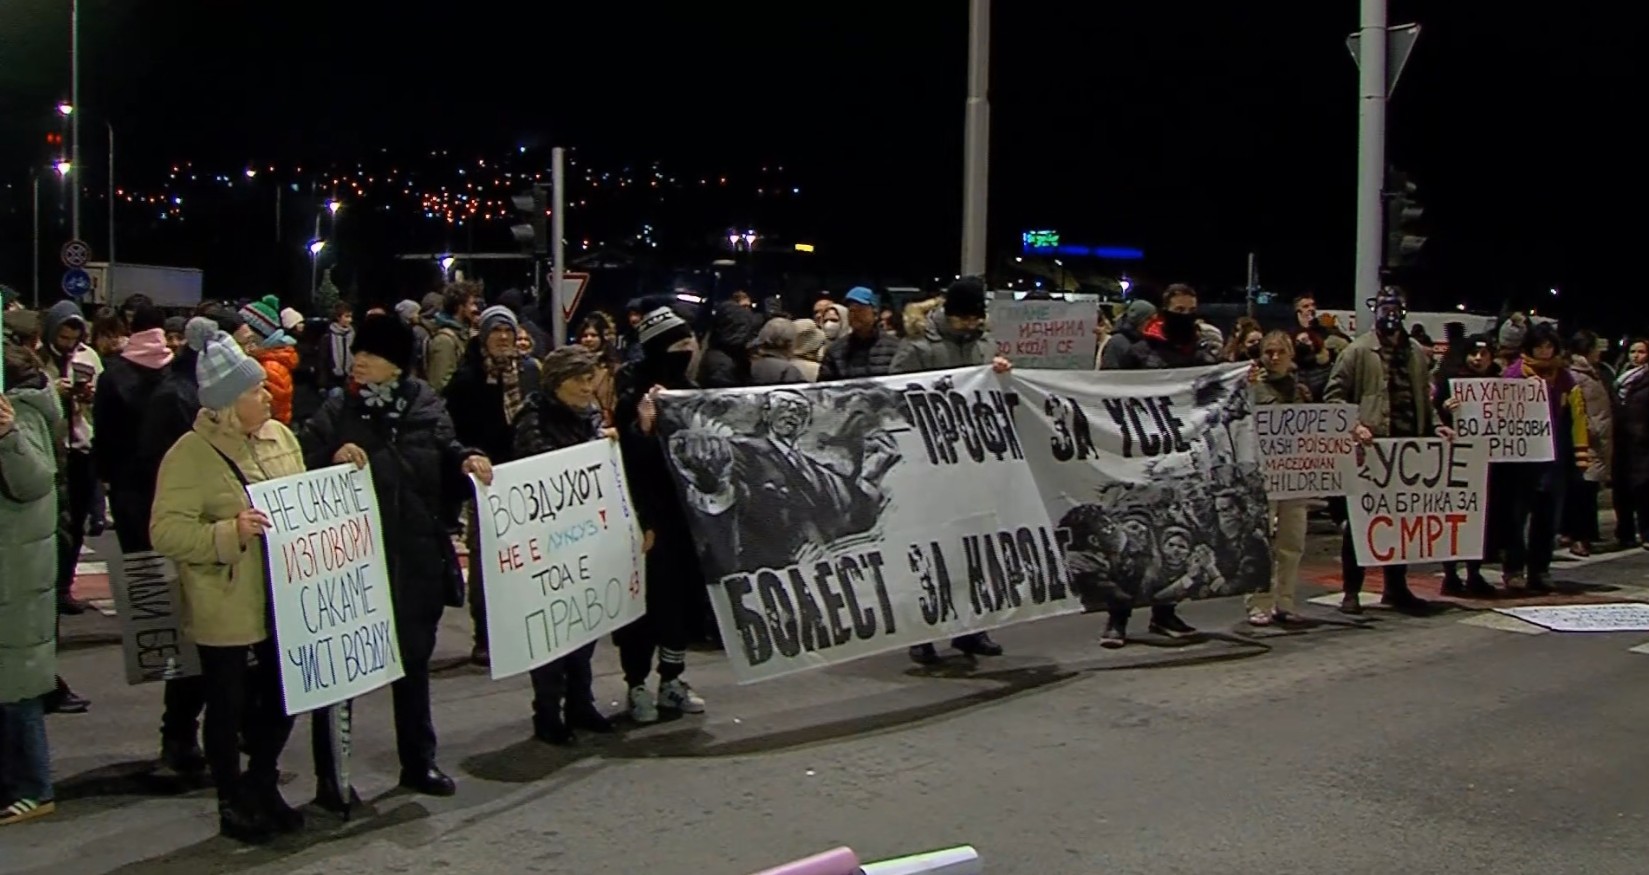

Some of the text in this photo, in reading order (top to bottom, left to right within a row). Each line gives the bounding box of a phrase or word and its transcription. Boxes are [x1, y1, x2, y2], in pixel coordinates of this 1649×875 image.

[1056, 340, 1075, 354] СЕ
[1454, 381, 1547, 402] НА ХАРТИЈА
[1482, 402, 1526, 420] БЕЛО
[1045, 394, 1099, 462] ЗА
[1101, 396, 1191, 458] УСЈЕ
[1256, 408, 1348, 436] EUROPE'S
[1456, 418, 1551, 437] ВО ДРОБОВИ
[1260, 437, 1352, 455] RASH POISONS
[1264, 457, 1335, 471] MACEDONIAN
[1368, 440, 1474, 489] УСЈЕ
[1488, 437, 1528, 457] РНО
[263, 469, 370, 534] НЕ САКАМЕ
[488, 463, 603, 539] ВОЗДУХОТ
[1361, 491, 1478, 516] ФАБРИКА ЗА
[282, 514, 376, 585] ИЗГОВОРИ
[499, 545, 524, 573] НЕ
[529, 538, 542, 562] Е
[1366, 514, 1468, 562] СМРТ
[532, 555, 592, 596] ТОА Е
[300, 563, 378, 634] САКАМЕ
[525, 577, 622, 660] ПРАВО
[723, 550, 896, 668] БОЛЕСТ
[907, 541, 959, 625] ЗА
[288, 619, 397, 693] ЧИСТ ВОЗДУХ
